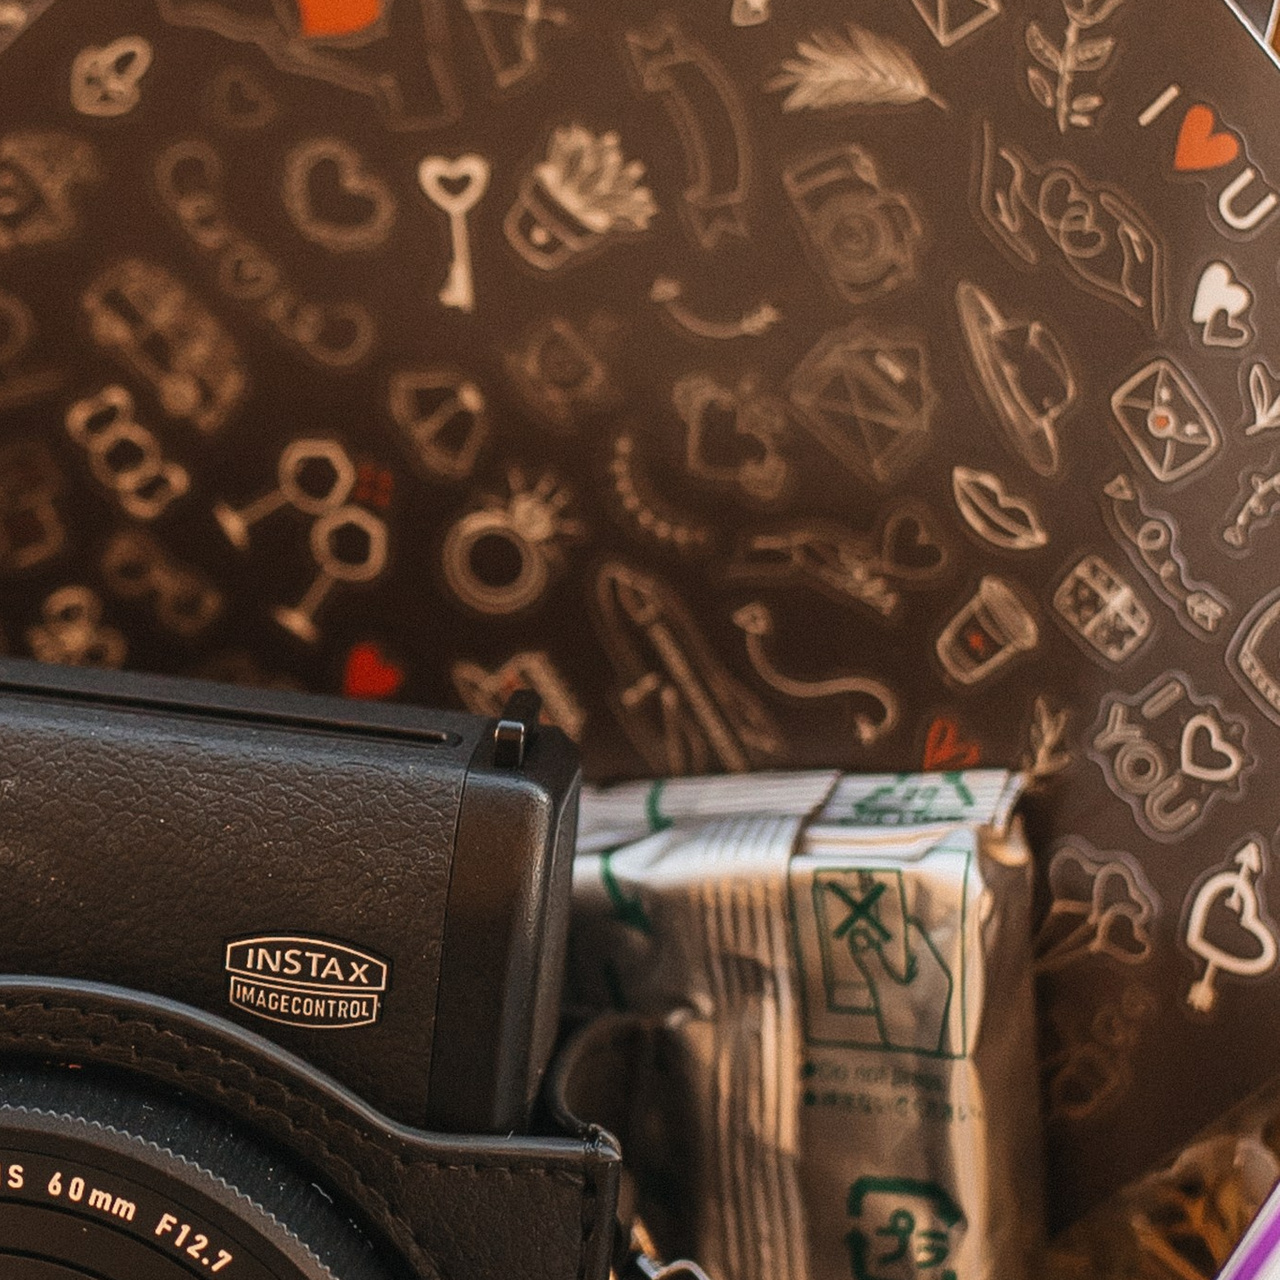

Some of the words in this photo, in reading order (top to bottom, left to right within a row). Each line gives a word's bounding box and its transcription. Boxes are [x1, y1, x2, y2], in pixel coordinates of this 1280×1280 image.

[1218, 167, 1278, 230] U
[1093, 702, 1199, 832] YOU
[245, 947, 370, 985] INSTAX
[235, 983, 370, 1020] IMAGECONTROL
[47, 1171, 138, 1221] 60mm
[154, 1212, 234, 1273] F12.7
